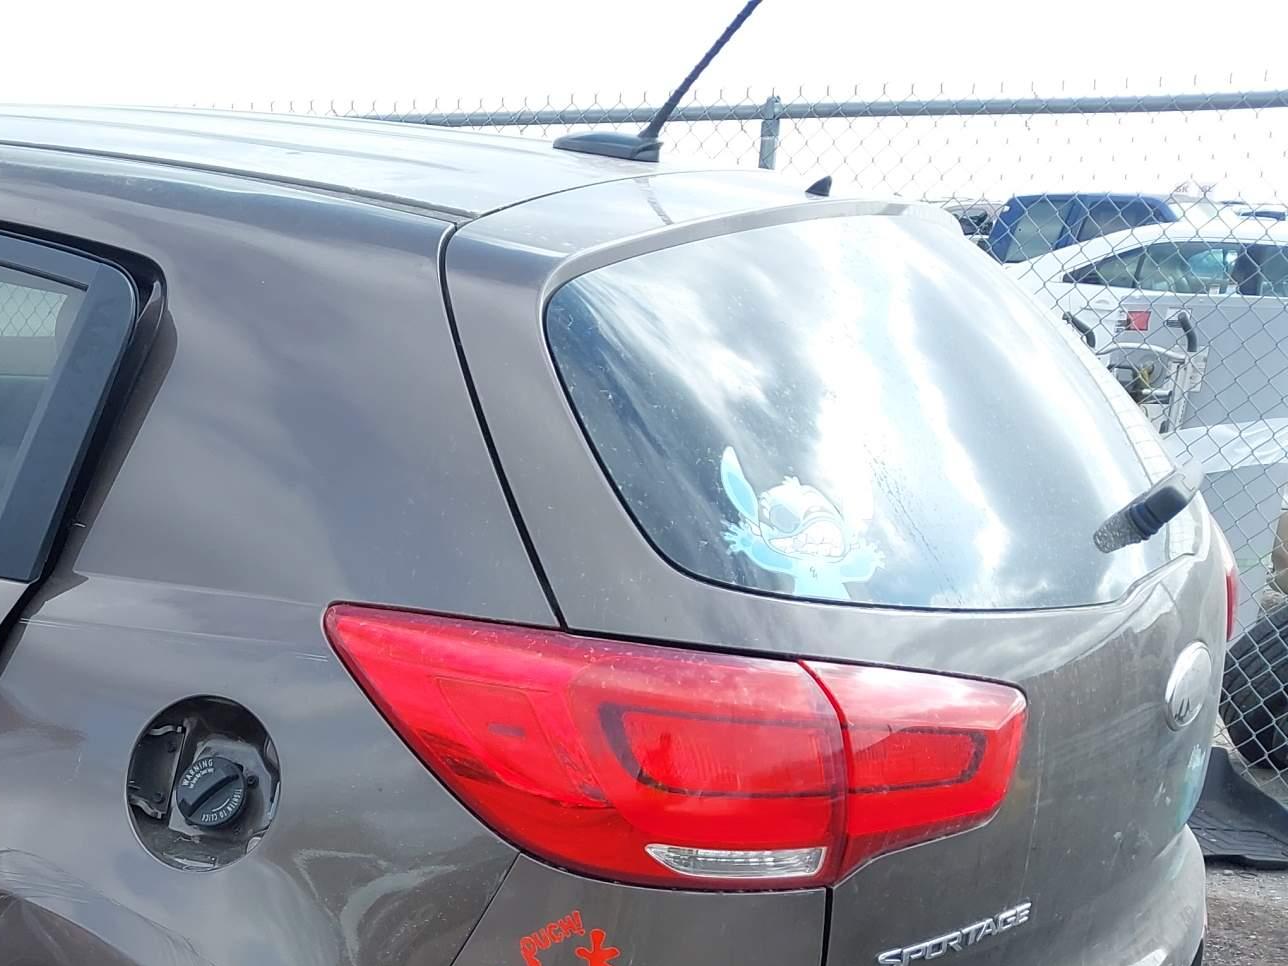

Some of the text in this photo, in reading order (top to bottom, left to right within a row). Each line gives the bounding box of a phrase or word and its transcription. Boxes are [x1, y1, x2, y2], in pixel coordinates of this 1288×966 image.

[182, 759, 213, 786] WARNING
[201, 813, 217, 821] CLICK
[520, 910, 585, 954] OUCH!
